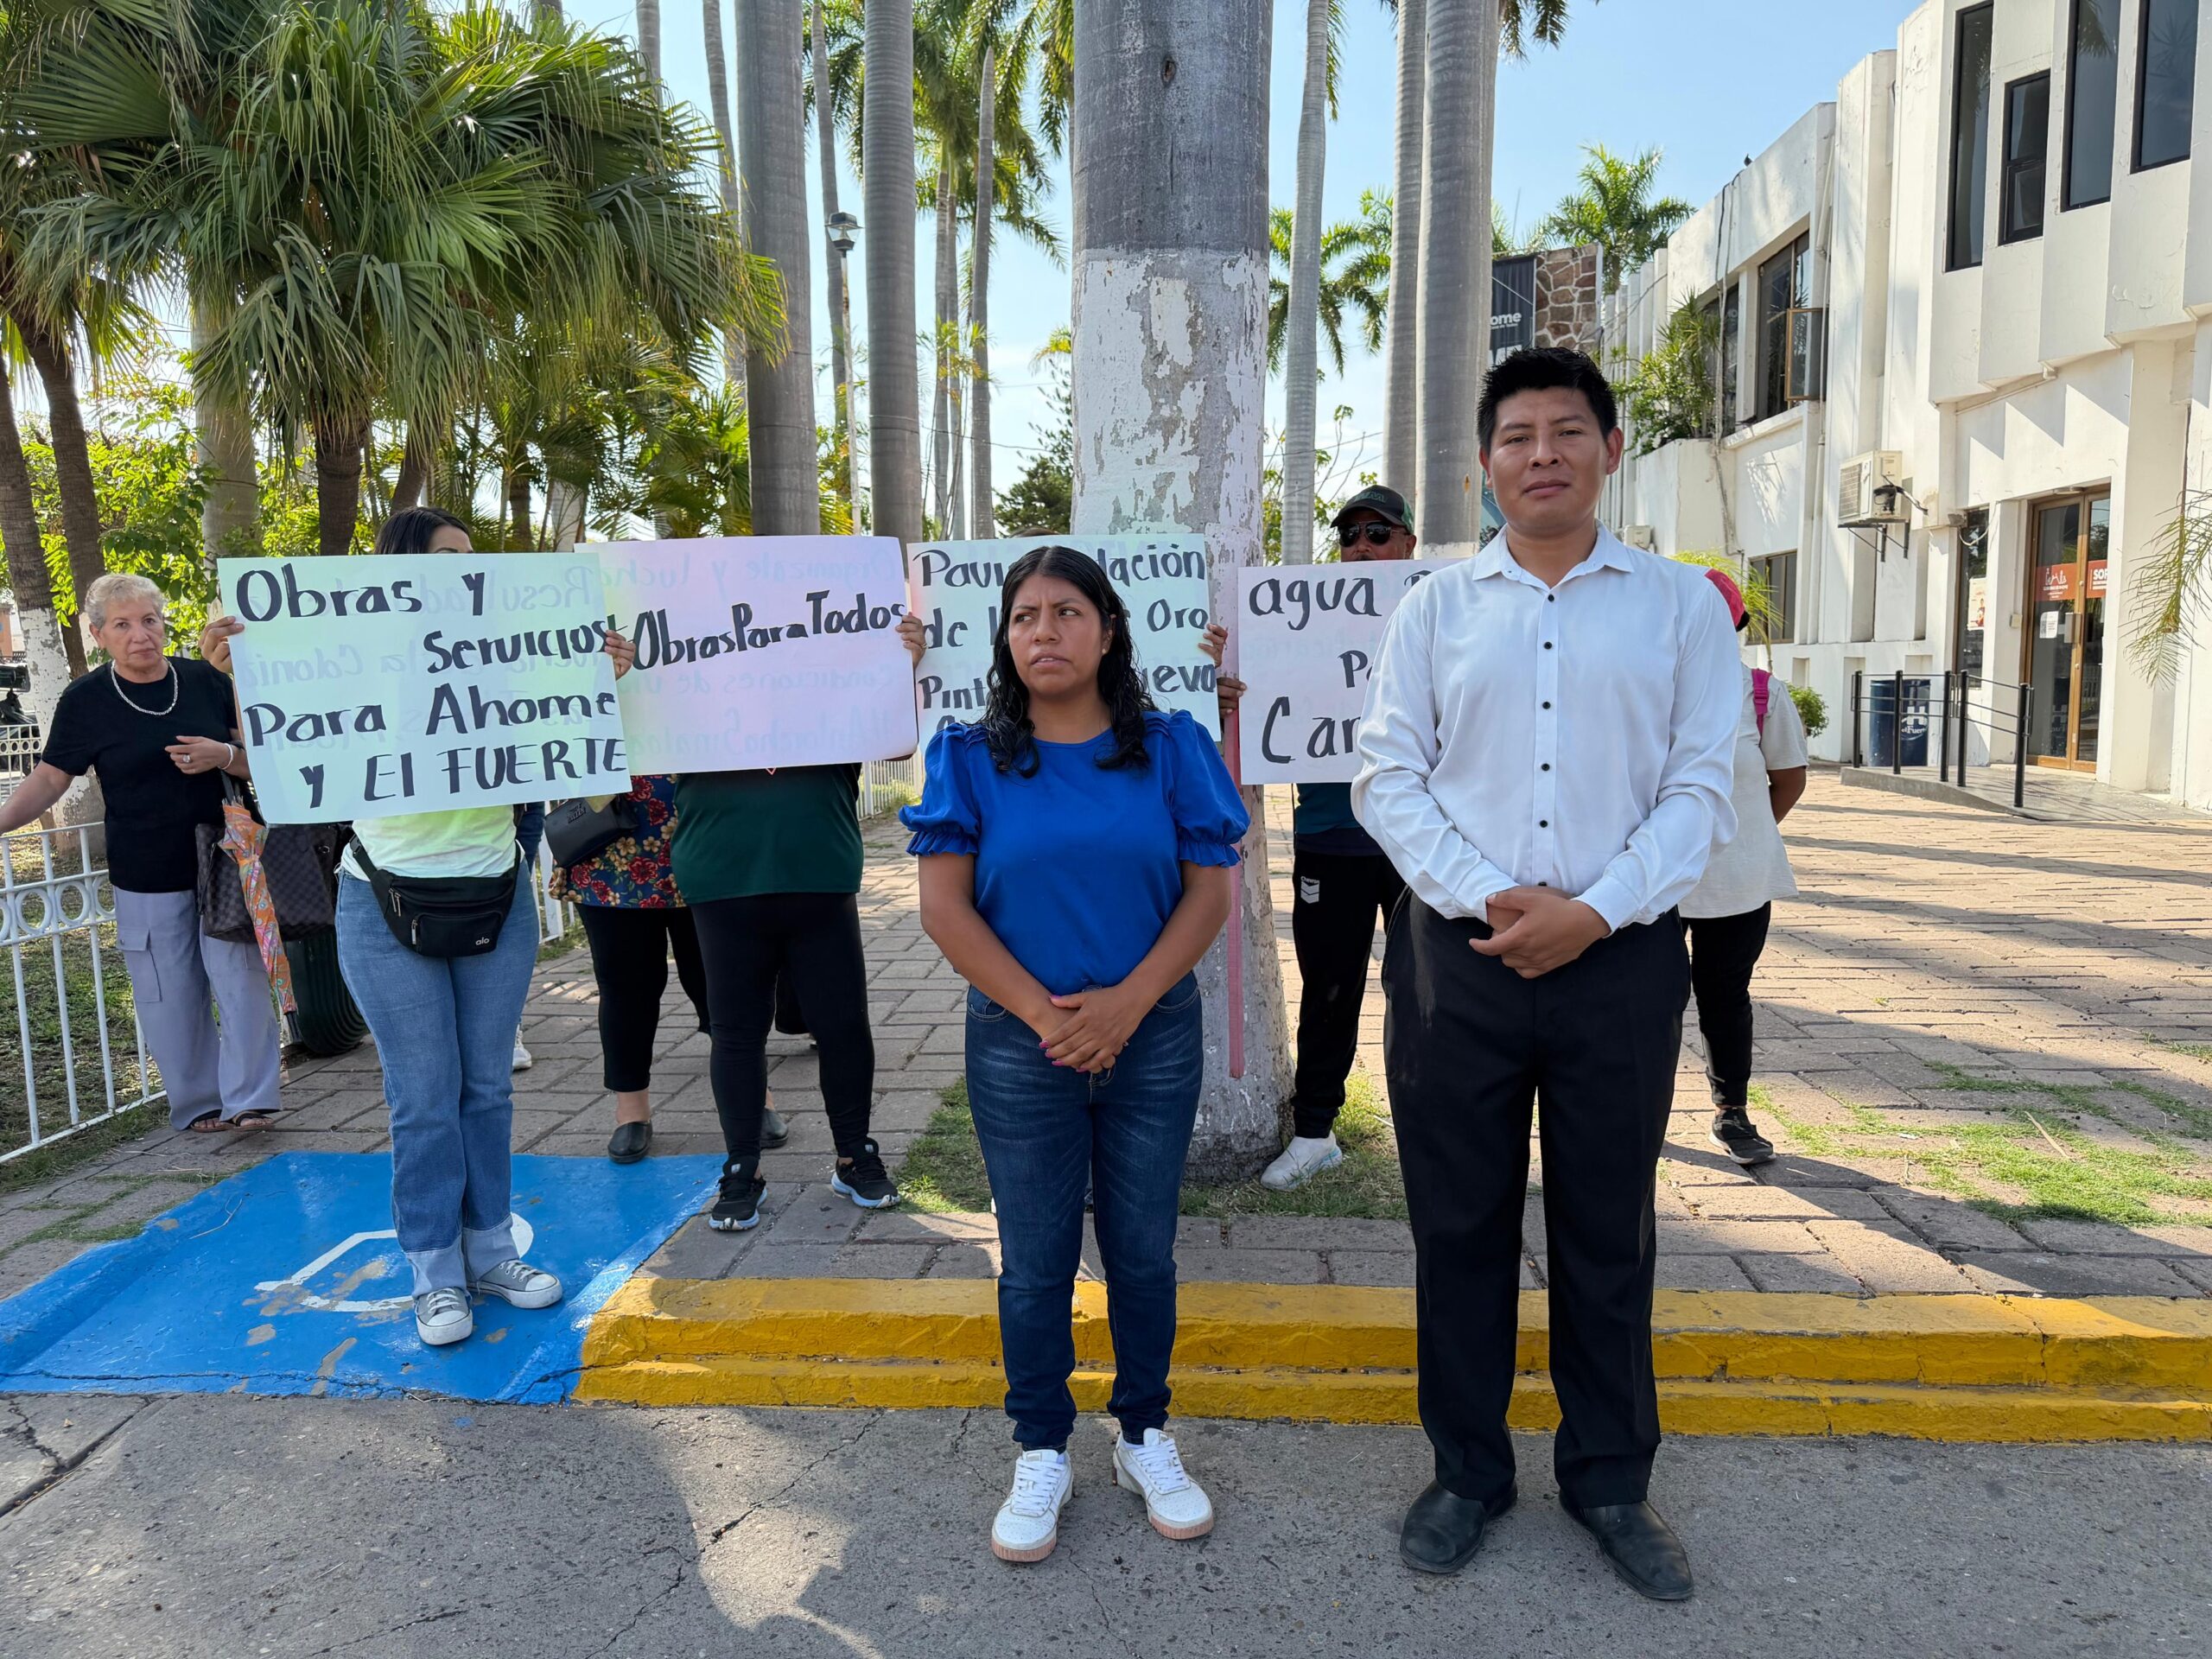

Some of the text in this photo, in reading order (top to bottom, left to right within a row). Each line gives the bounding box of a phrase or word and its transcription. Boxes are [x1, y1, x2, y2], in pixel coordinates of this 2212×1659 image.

[1490, 312, 1522, 325] ome
[236, 563, 423, 622] Obras
[1249, 577, 1382, 631] agua
[423, 620, 607, 674] Servicios
[632, 608, 736, 671] Obras
[731, 602, 809, 652] Para
[923, 607, 969, 650] de
[1147, 598, 1209, 632] Oro
[242, 702, 386, 747] Para
[425, 682, 616, 735] Ahome
[918, 675, 987, 709] Pint
[436, 737, 627, 794] FUERTE
[475, 937, 490, 946] alo
